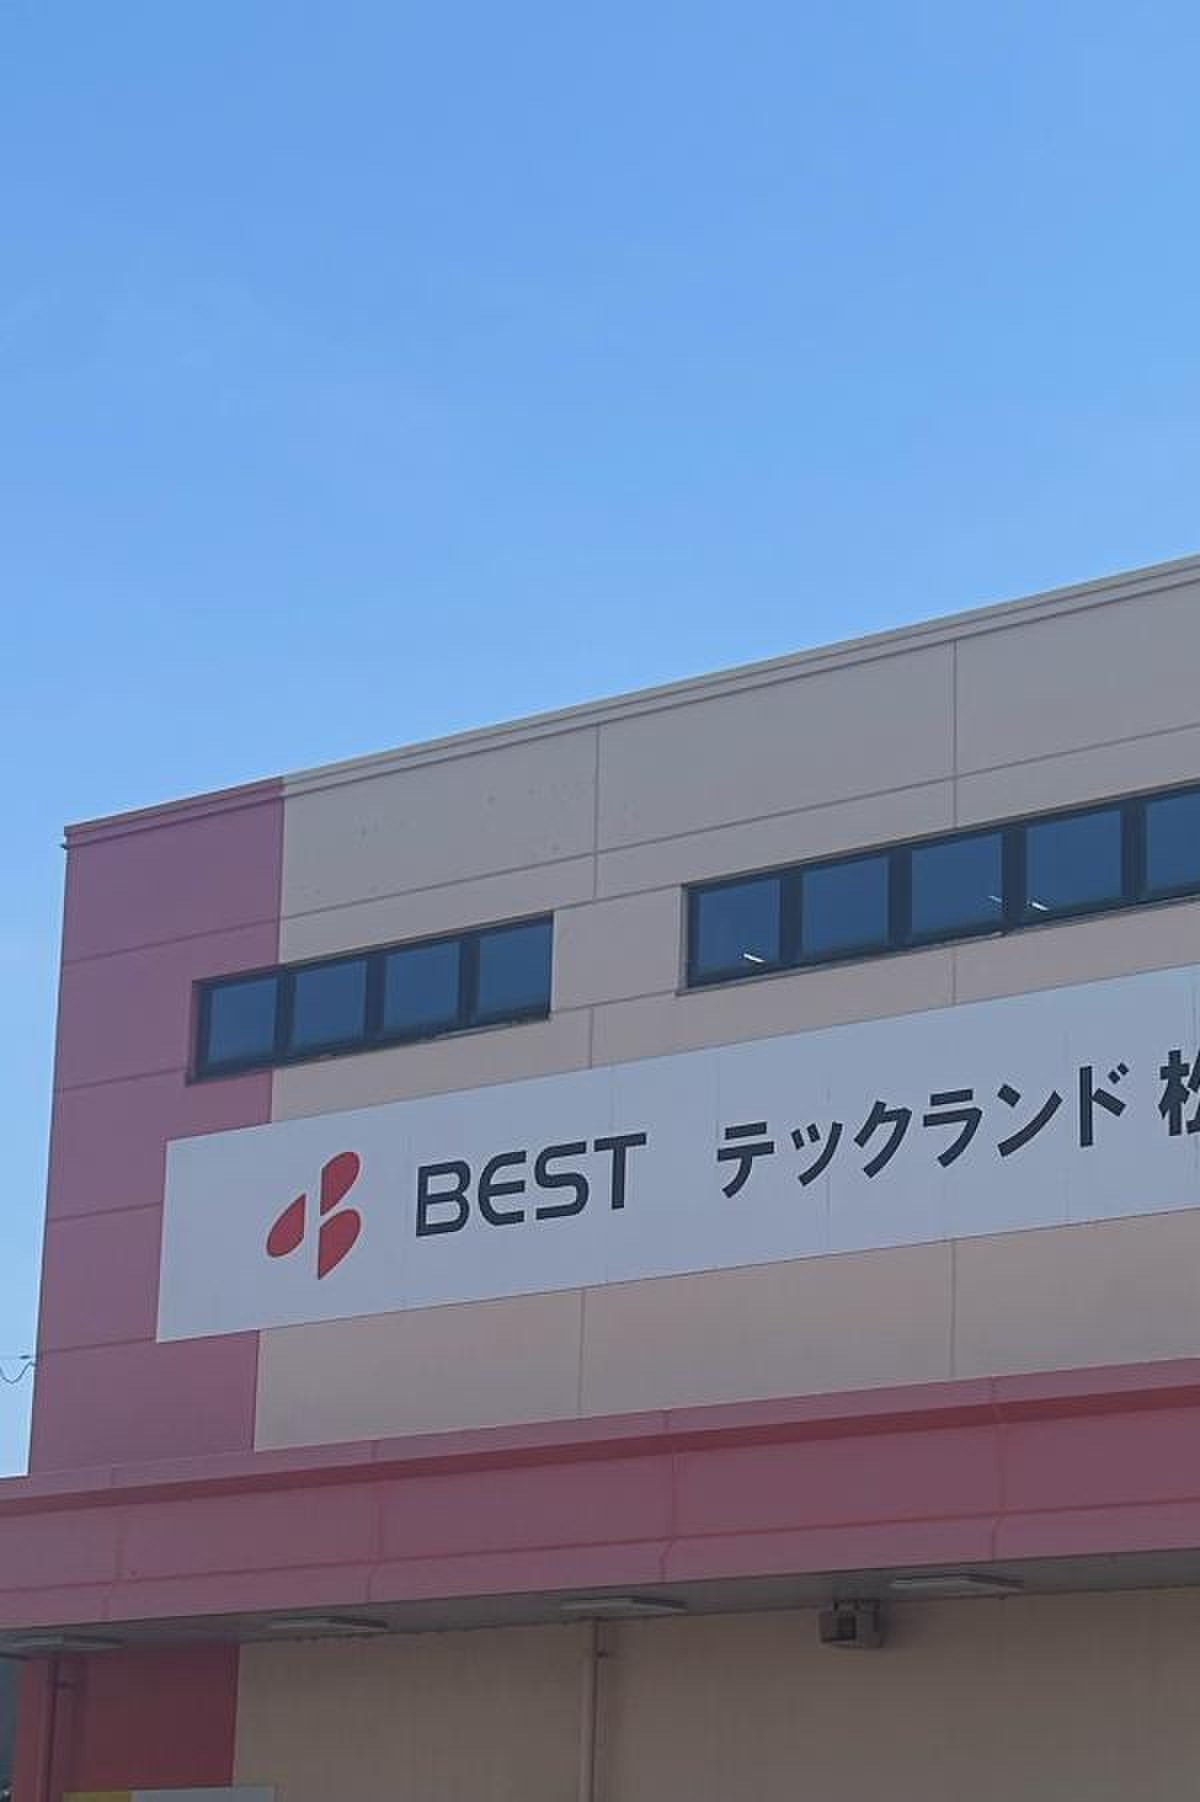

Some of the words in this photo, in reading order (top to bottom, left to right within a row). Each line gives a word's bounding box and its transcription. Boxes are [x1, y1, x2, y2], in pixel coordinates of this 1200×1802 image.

[416, 1132, 646, 1237] BEST
[717, 1063, 1129, 1198] テックランド
